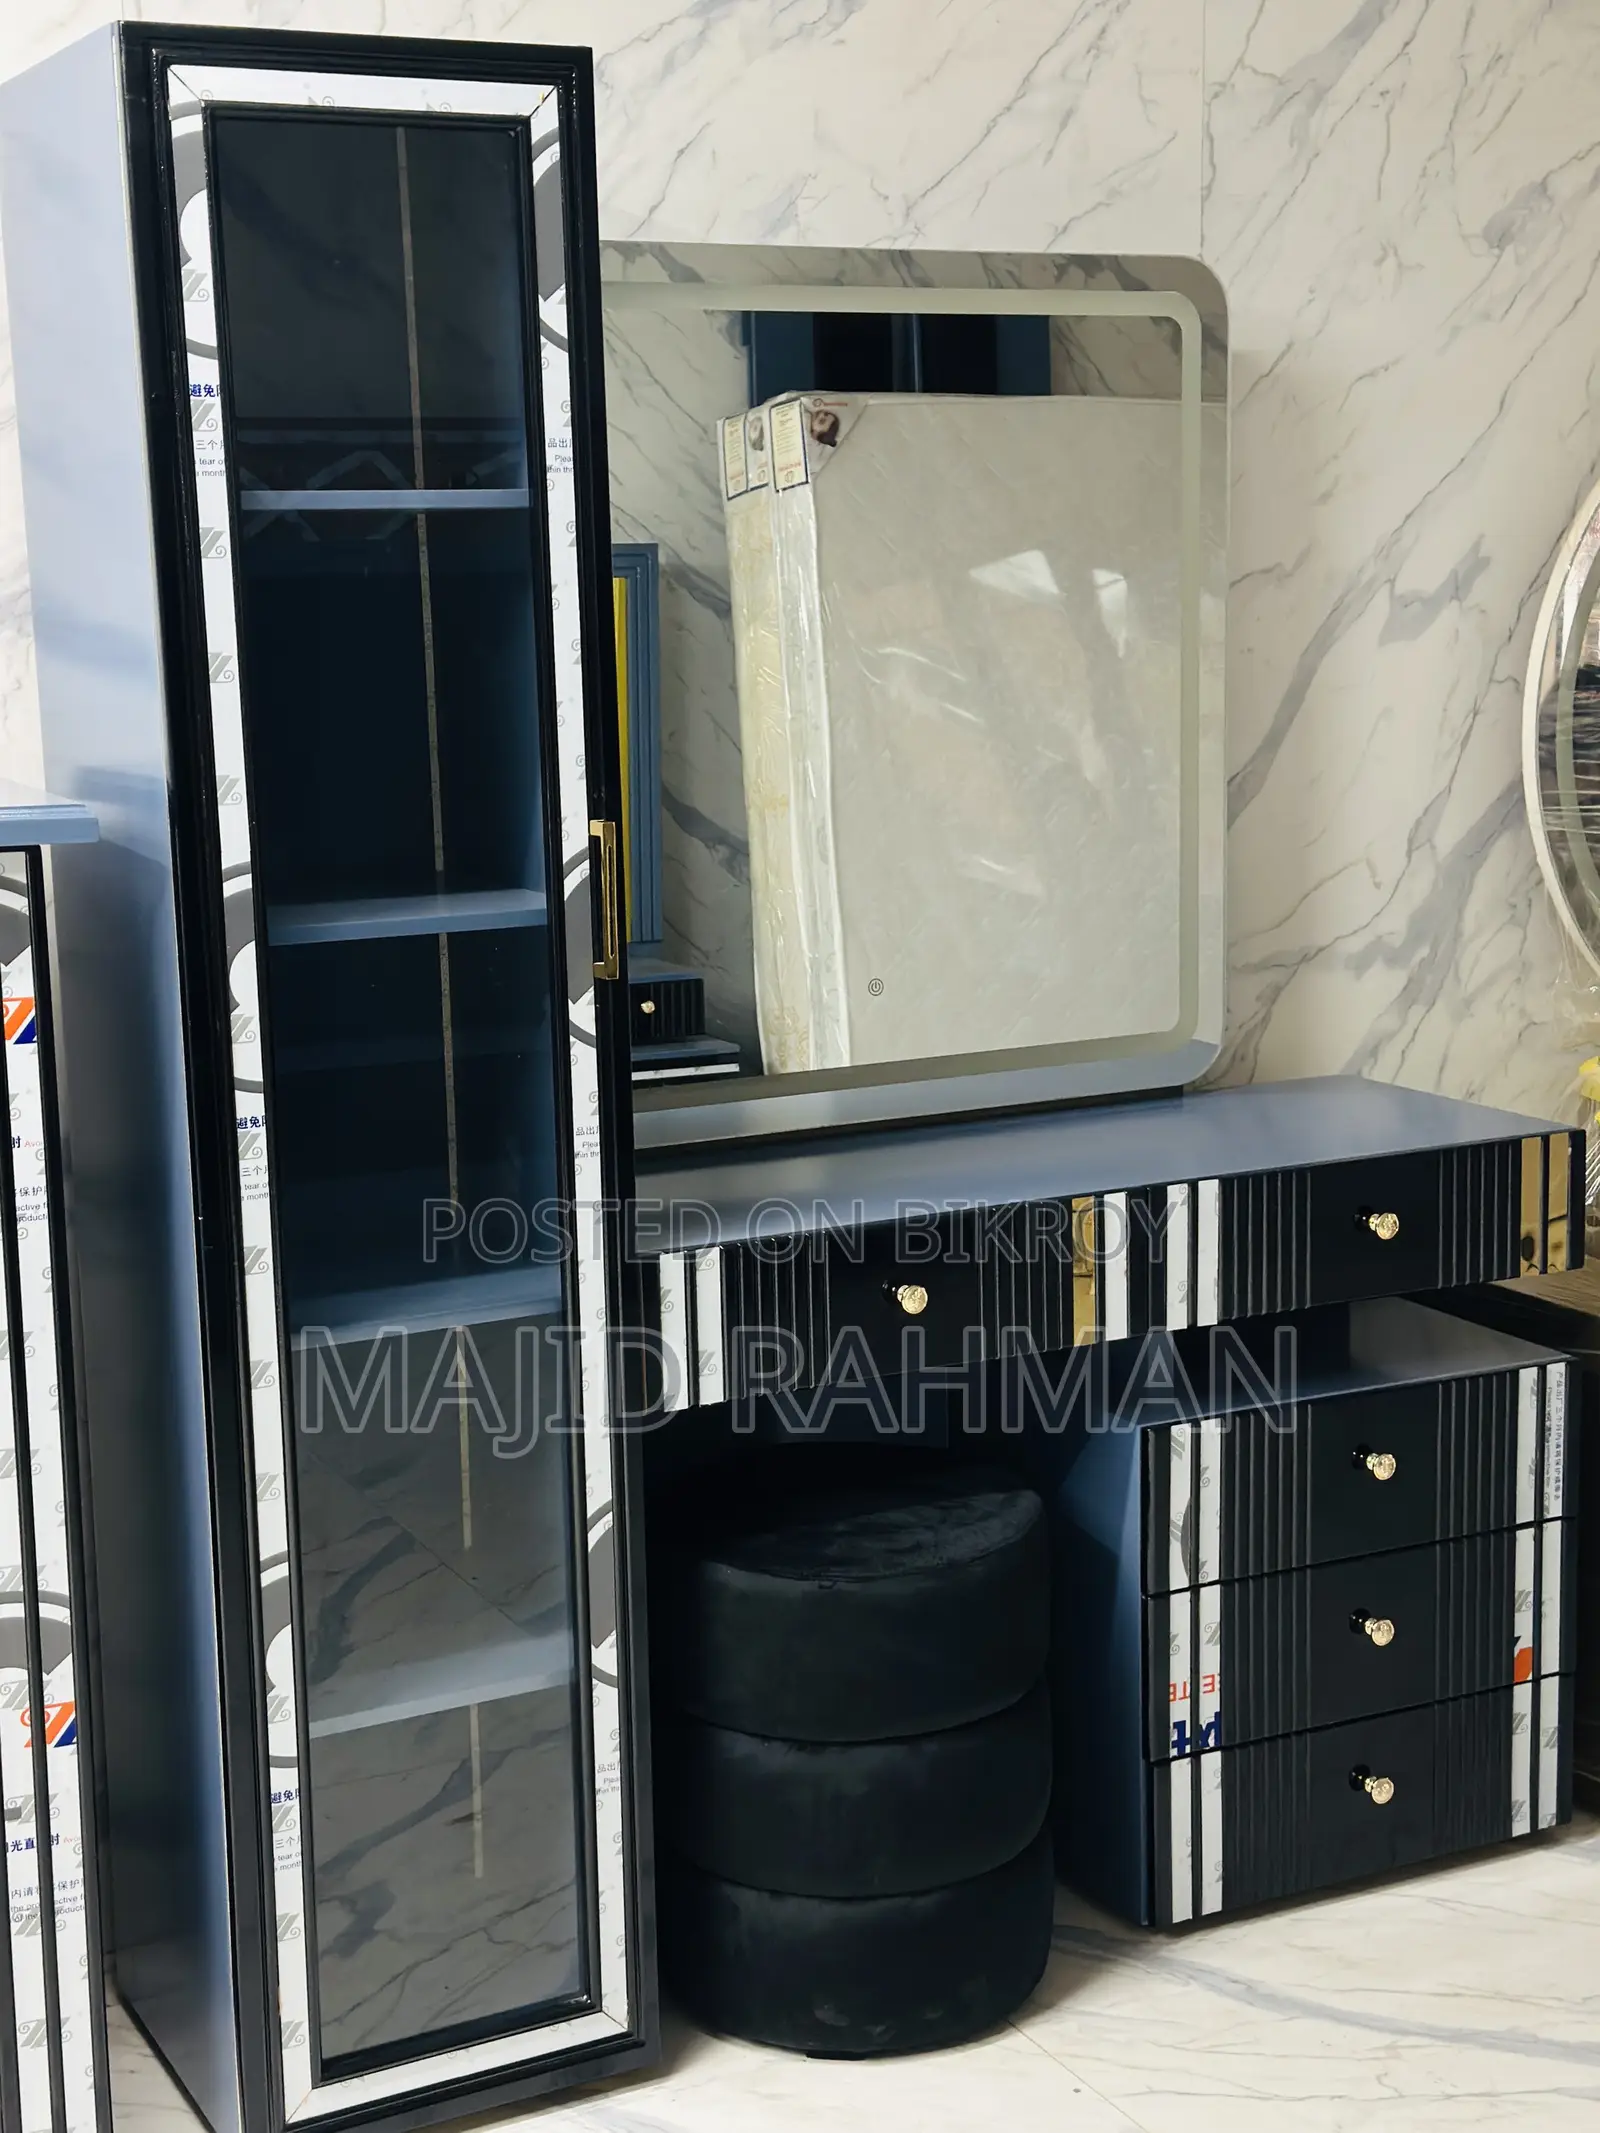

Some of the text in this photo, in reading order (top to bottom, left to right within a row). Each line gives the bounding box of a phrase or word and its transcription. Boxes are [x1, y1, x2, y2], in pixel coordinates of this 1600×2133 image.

[555, 454, 572, 462] Plea
[7, 1837, 35, 1852] 光直
[12, 1885, 38, 1899] 内请
